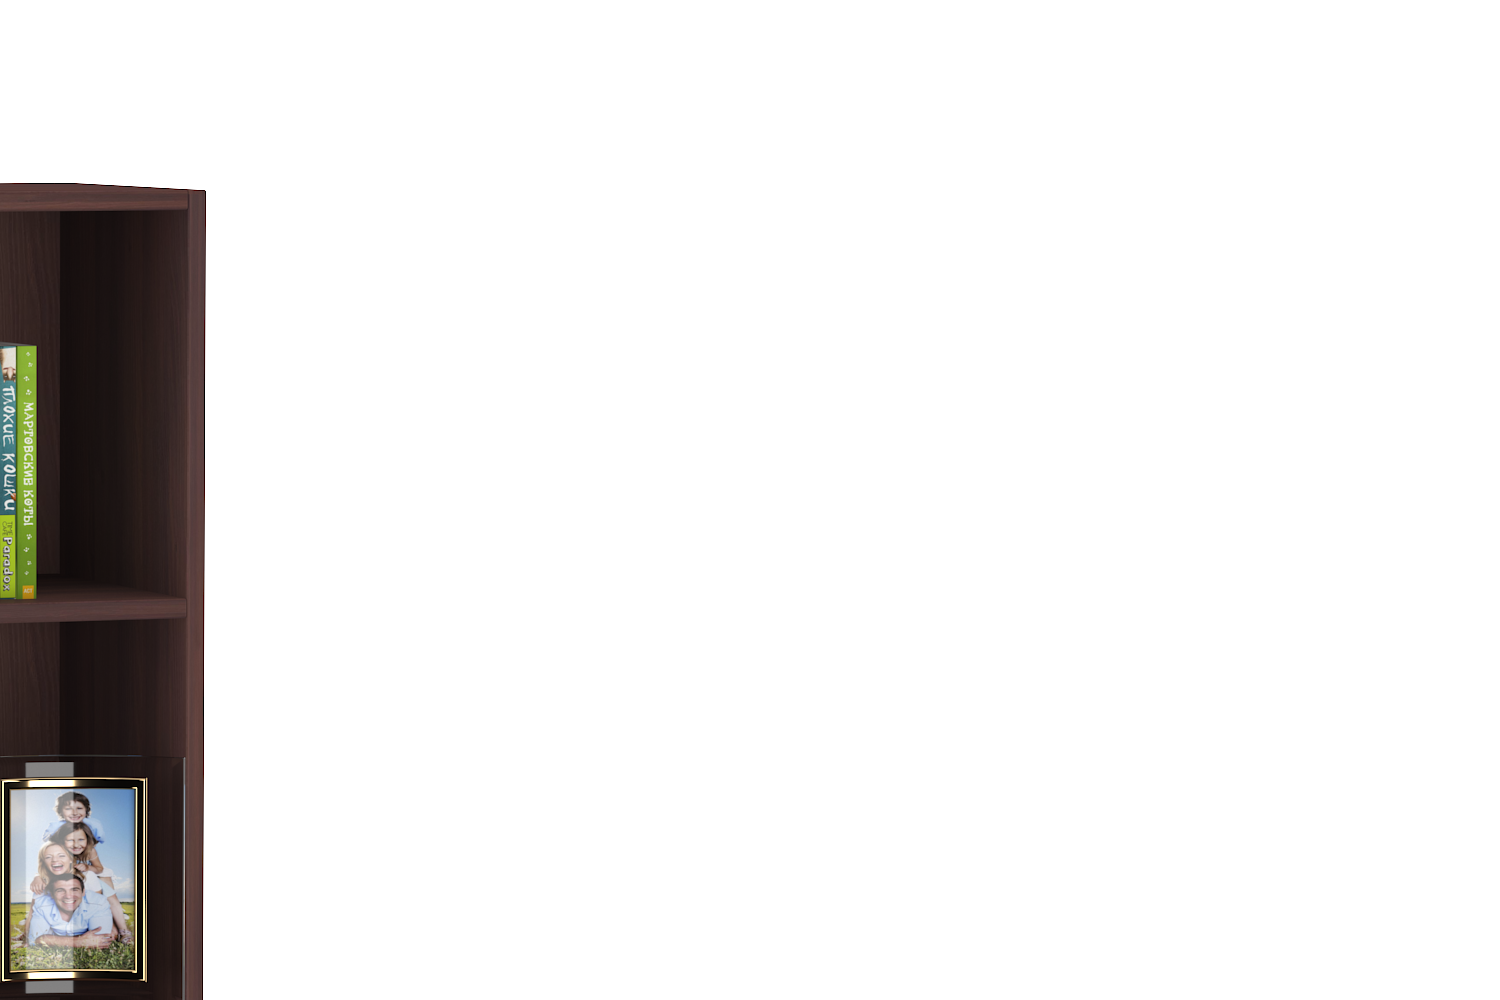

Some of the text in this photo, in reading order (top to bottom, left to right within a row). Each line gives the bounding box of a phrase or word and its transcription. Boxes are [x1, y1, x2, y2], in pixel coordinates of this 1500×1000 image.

[1, 385, 16, 511] ПЛОХИЕ КОШКИ
[23, 402, 34, 526] МАРТОВСКИЕ КОТЫ
[3, 536, 13, 591] Paradox
